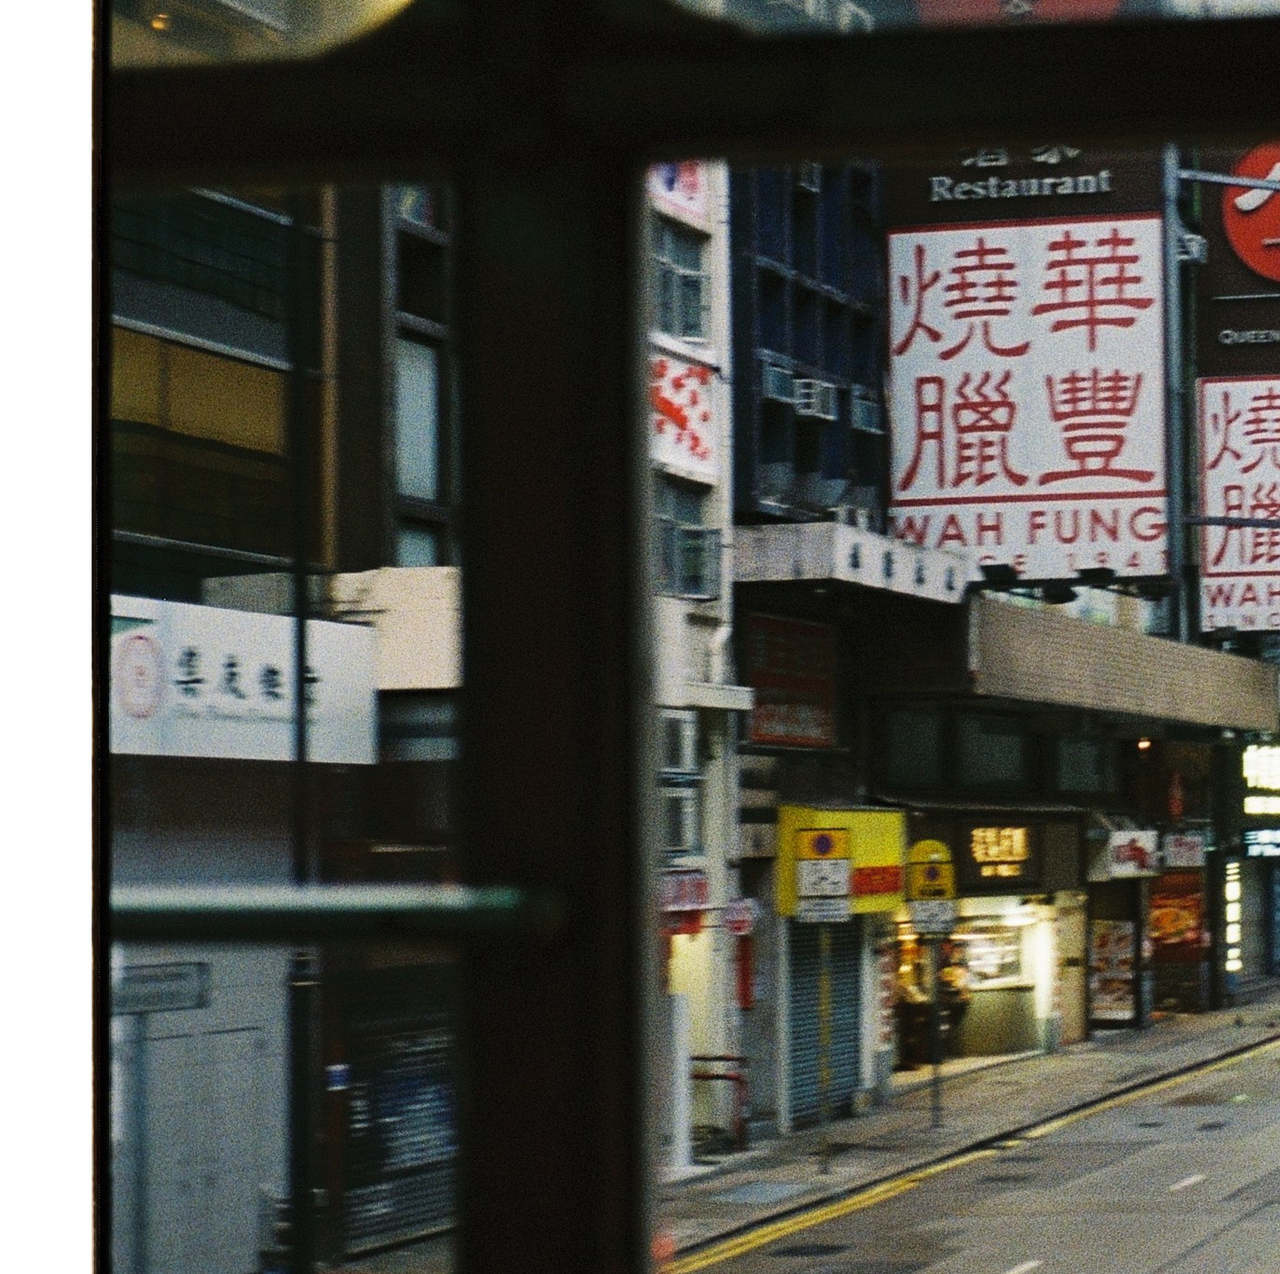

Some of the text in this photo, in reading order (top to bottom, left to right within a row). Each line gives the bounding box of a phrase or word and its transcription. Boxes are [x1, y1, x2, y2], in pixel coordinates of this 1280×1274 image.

[929, 170, 1112, 202] Restaurant
[889, 506, 1169, 548] WAH FUNG
